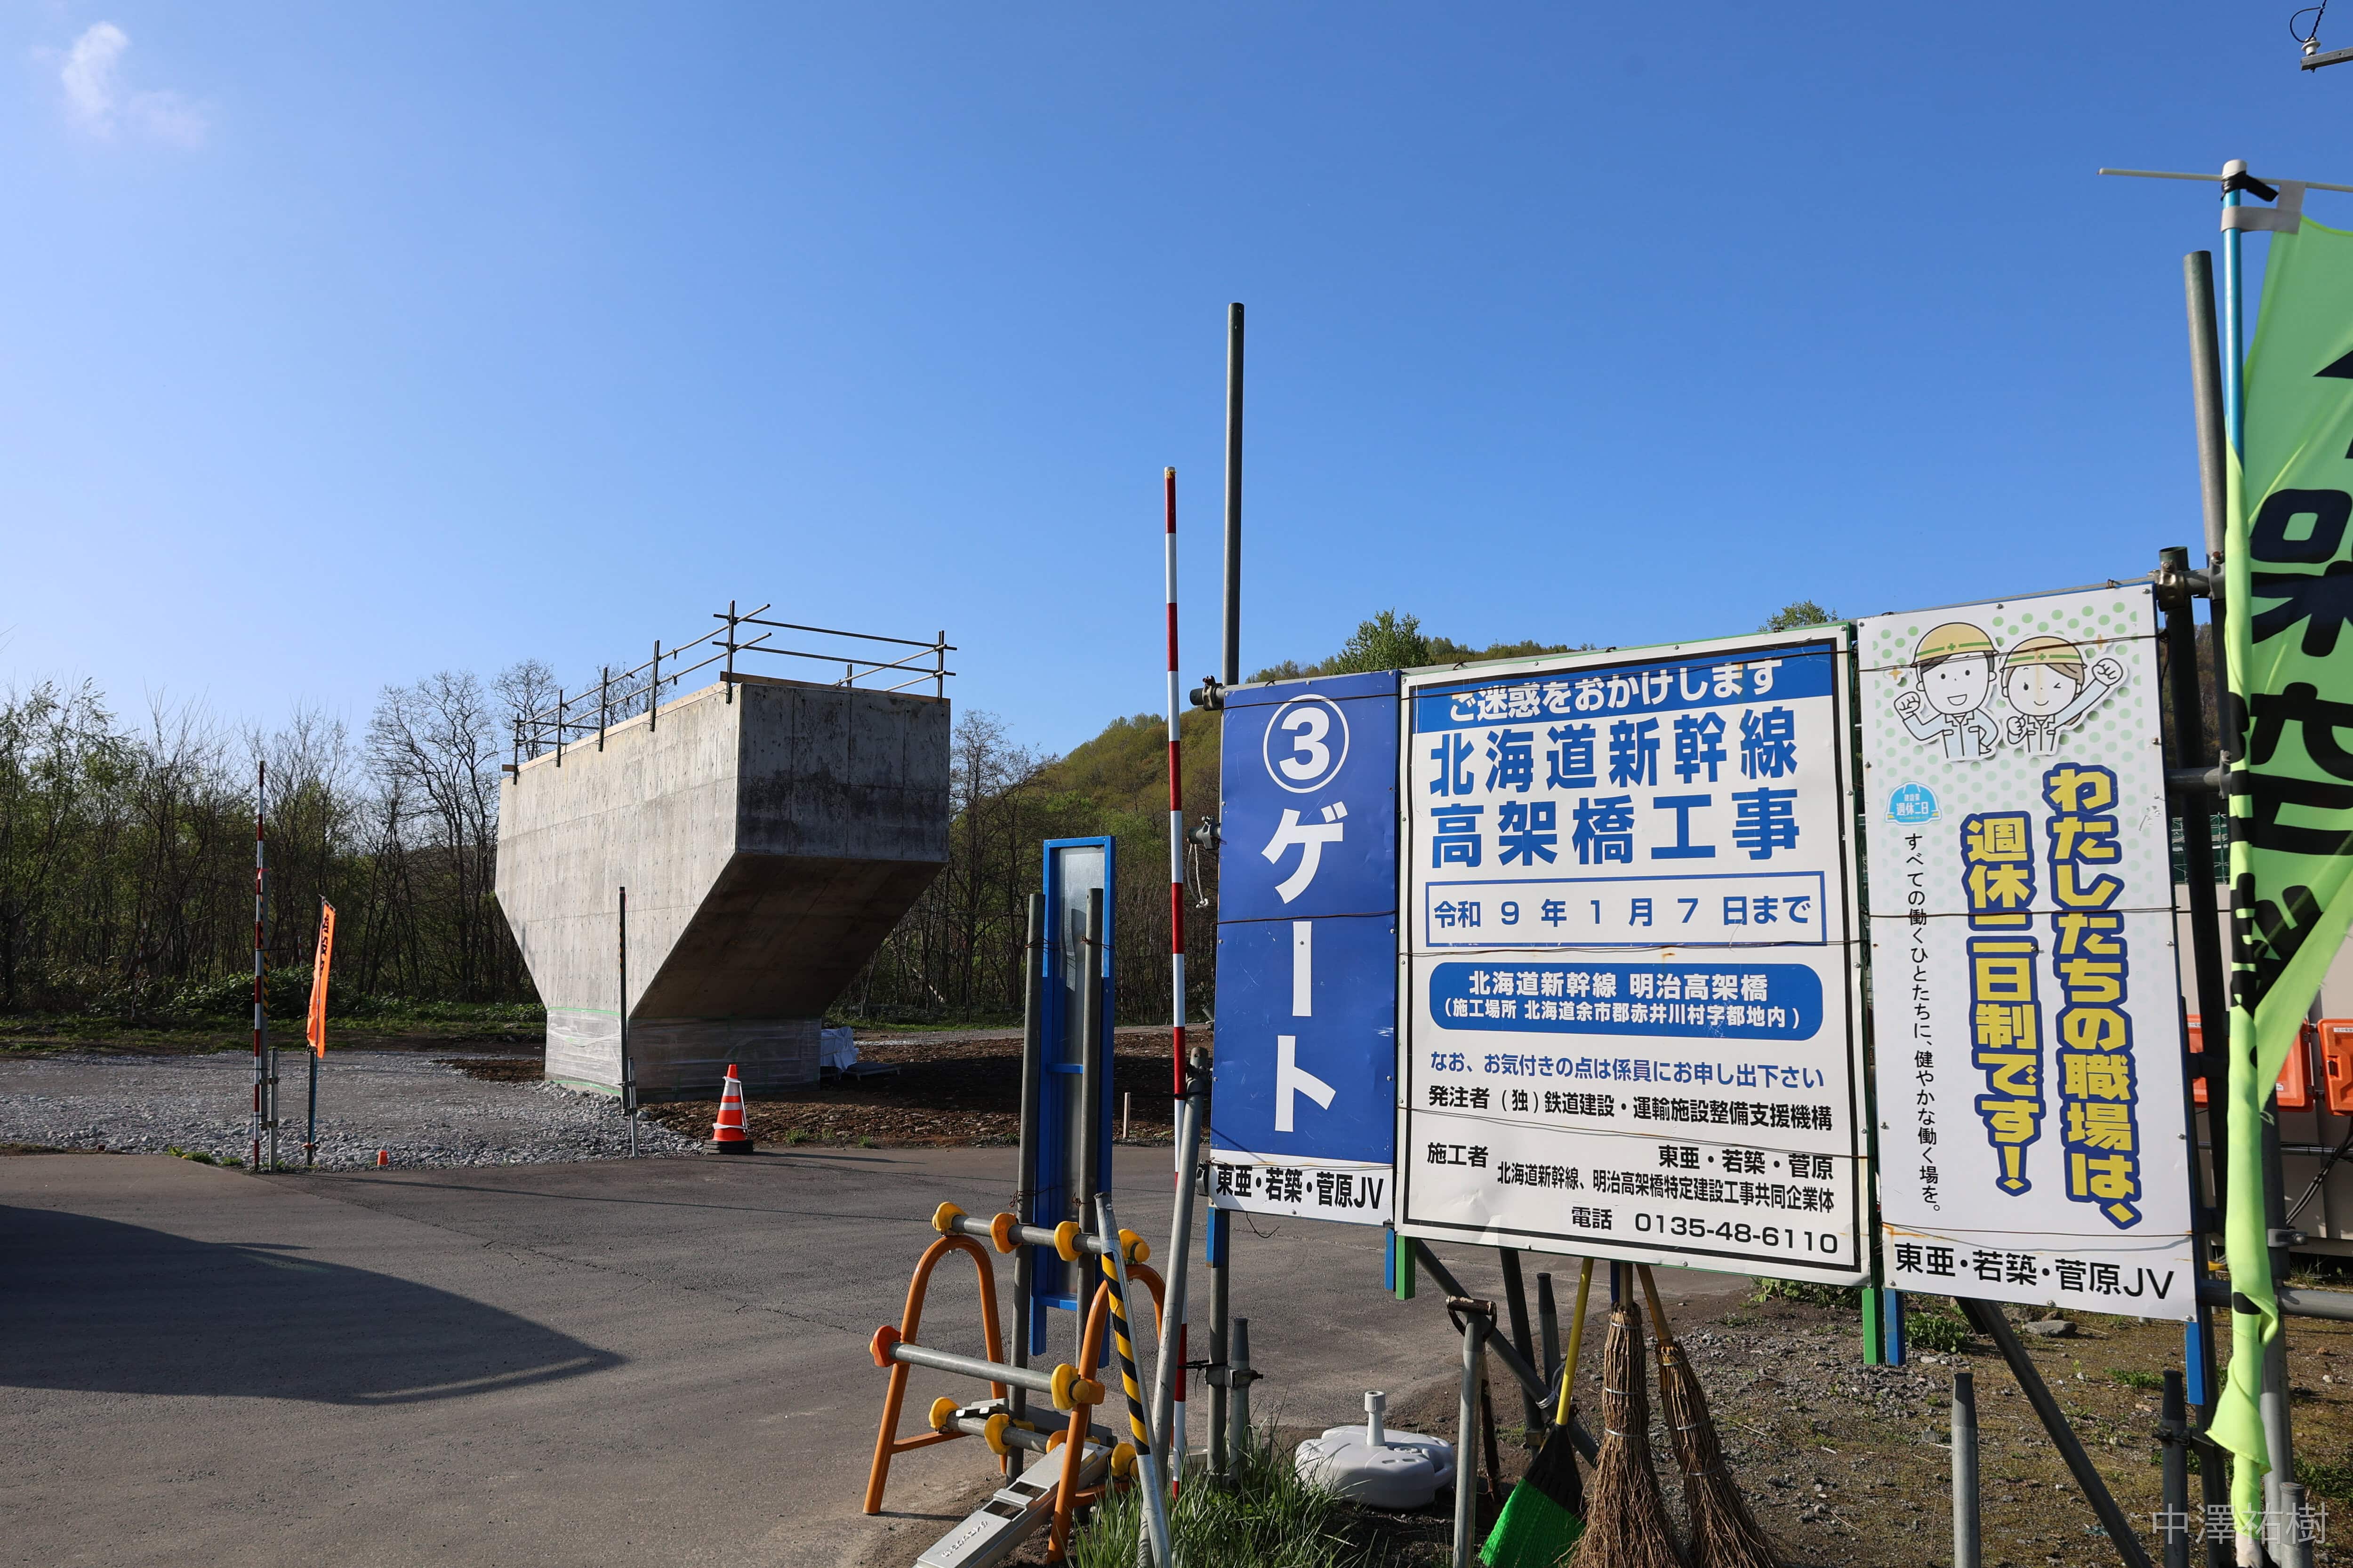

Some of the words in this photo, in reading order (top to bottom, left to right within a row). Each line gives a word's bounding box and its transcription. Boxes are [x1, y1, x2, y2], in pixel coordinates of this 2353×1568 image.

[1449, 659, 1783, 722] ご迷惑をおかけします
[1429, 706, 1798, 797] 北海道新幹線
[1430, 787, 1800, 869] 高架橋工事
[1469, 969, 1617, 998] 北海道新幹線
[1630, 973, 1768, 1002] 明治高架橋
[1961, 810, 2047, 1197] 週休二日制です！
[2042, 762, 2143, 1229] わたしたちの職場は、
[1904, 832, 1941, 1212] すべての働くひとたちに、健やかな働く場を。
[1430, 1051, 1823, 1088] なお、お気付きの点は係員にお申し出下さい
[1429, 1085, 1490, 1110] 発注者
[1216, 1164, 1384, 1210] 東亜・若築・菅原JV
[1427, 1143, 1489, 1169] 施工者
[1658, 1144, 1833, 1180] 東亜・若築・菅原
[1497, 1161, 1834, 1213] 北海道新幹線、明治高架橋特定建設工事共同企業体
[1571, 1206, 1613, 1232] 電話
[1634, 1213, 1839, 1254] 0135-48-6110
[1894, 1243, 2175, 1300] 東亜・若築・菅原JV
